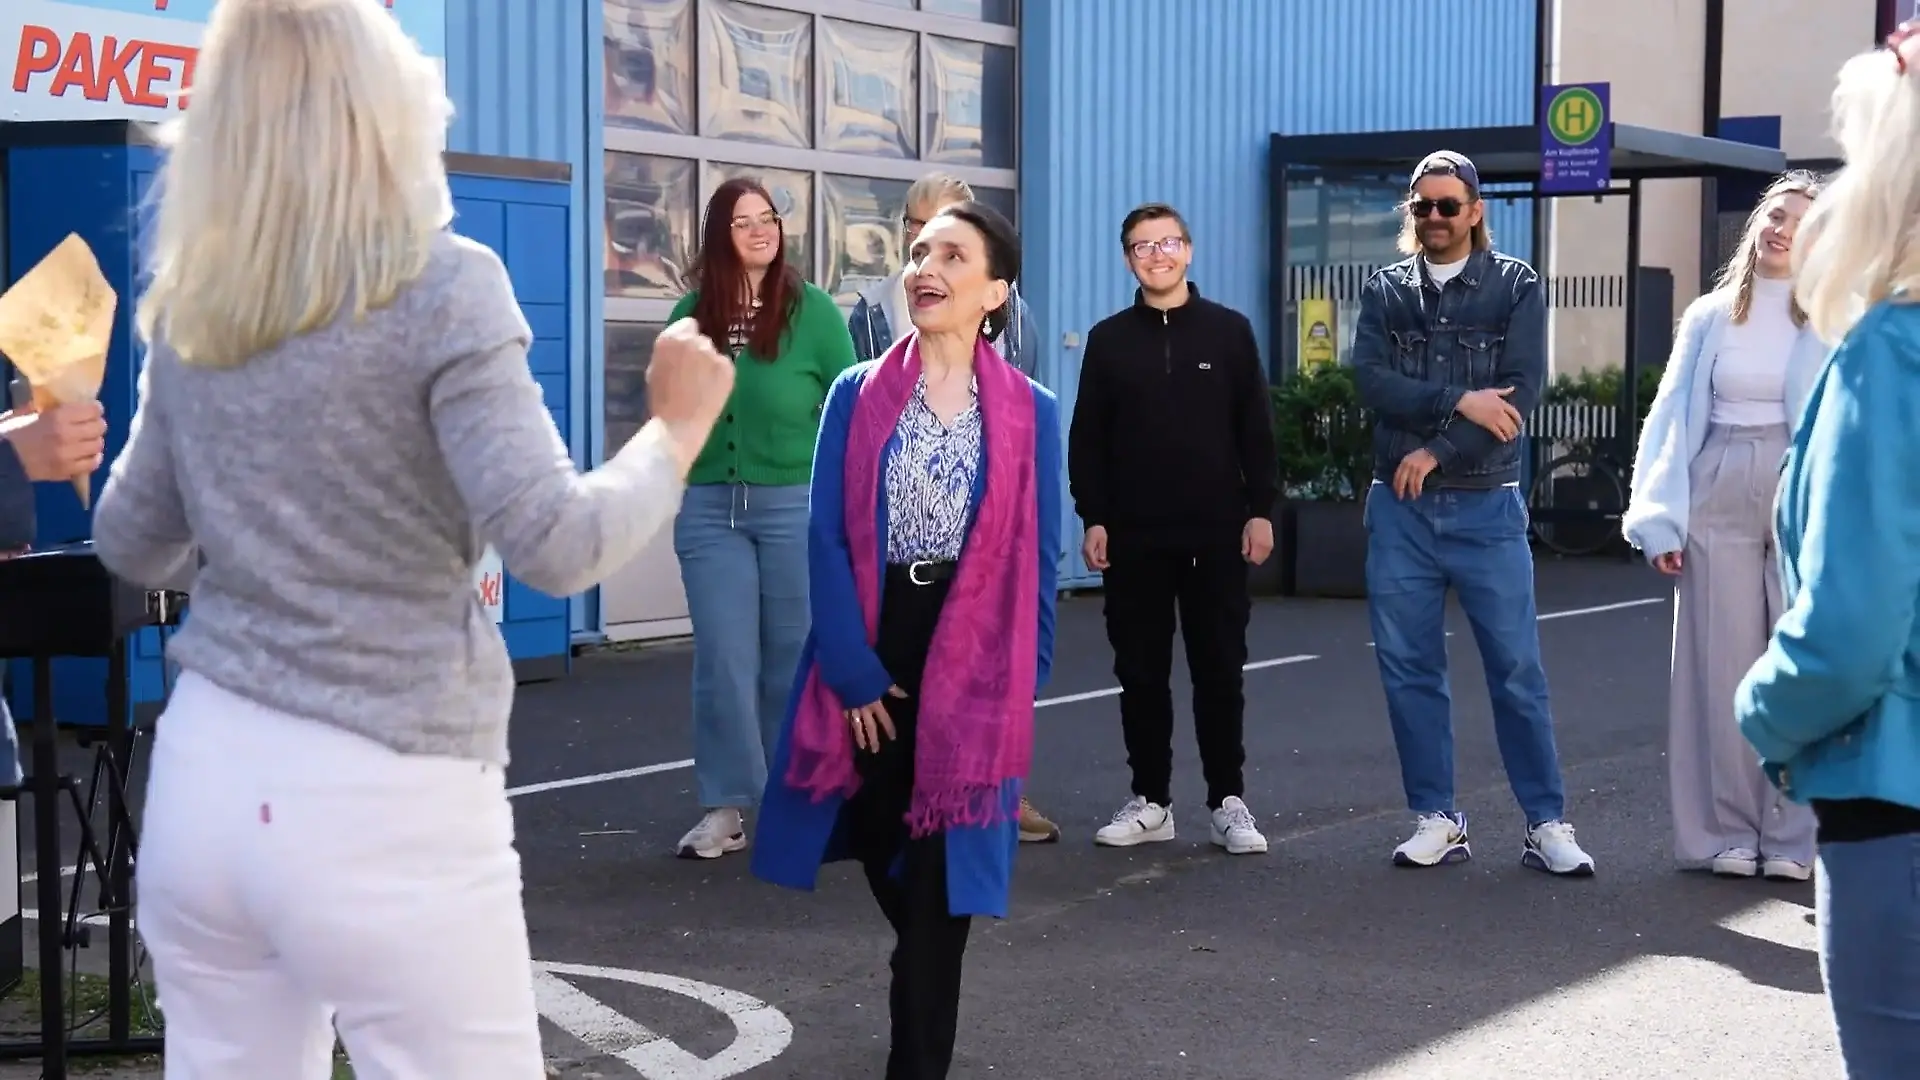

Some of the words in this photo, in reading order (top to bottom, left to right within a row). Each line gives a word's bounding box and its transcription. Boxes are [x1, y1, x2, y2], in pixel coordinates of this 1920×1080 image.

[12, 24, 200, 110] PAKET
[1564, 101, 1586, 131] H
[480, 571, 501, 606] k!
